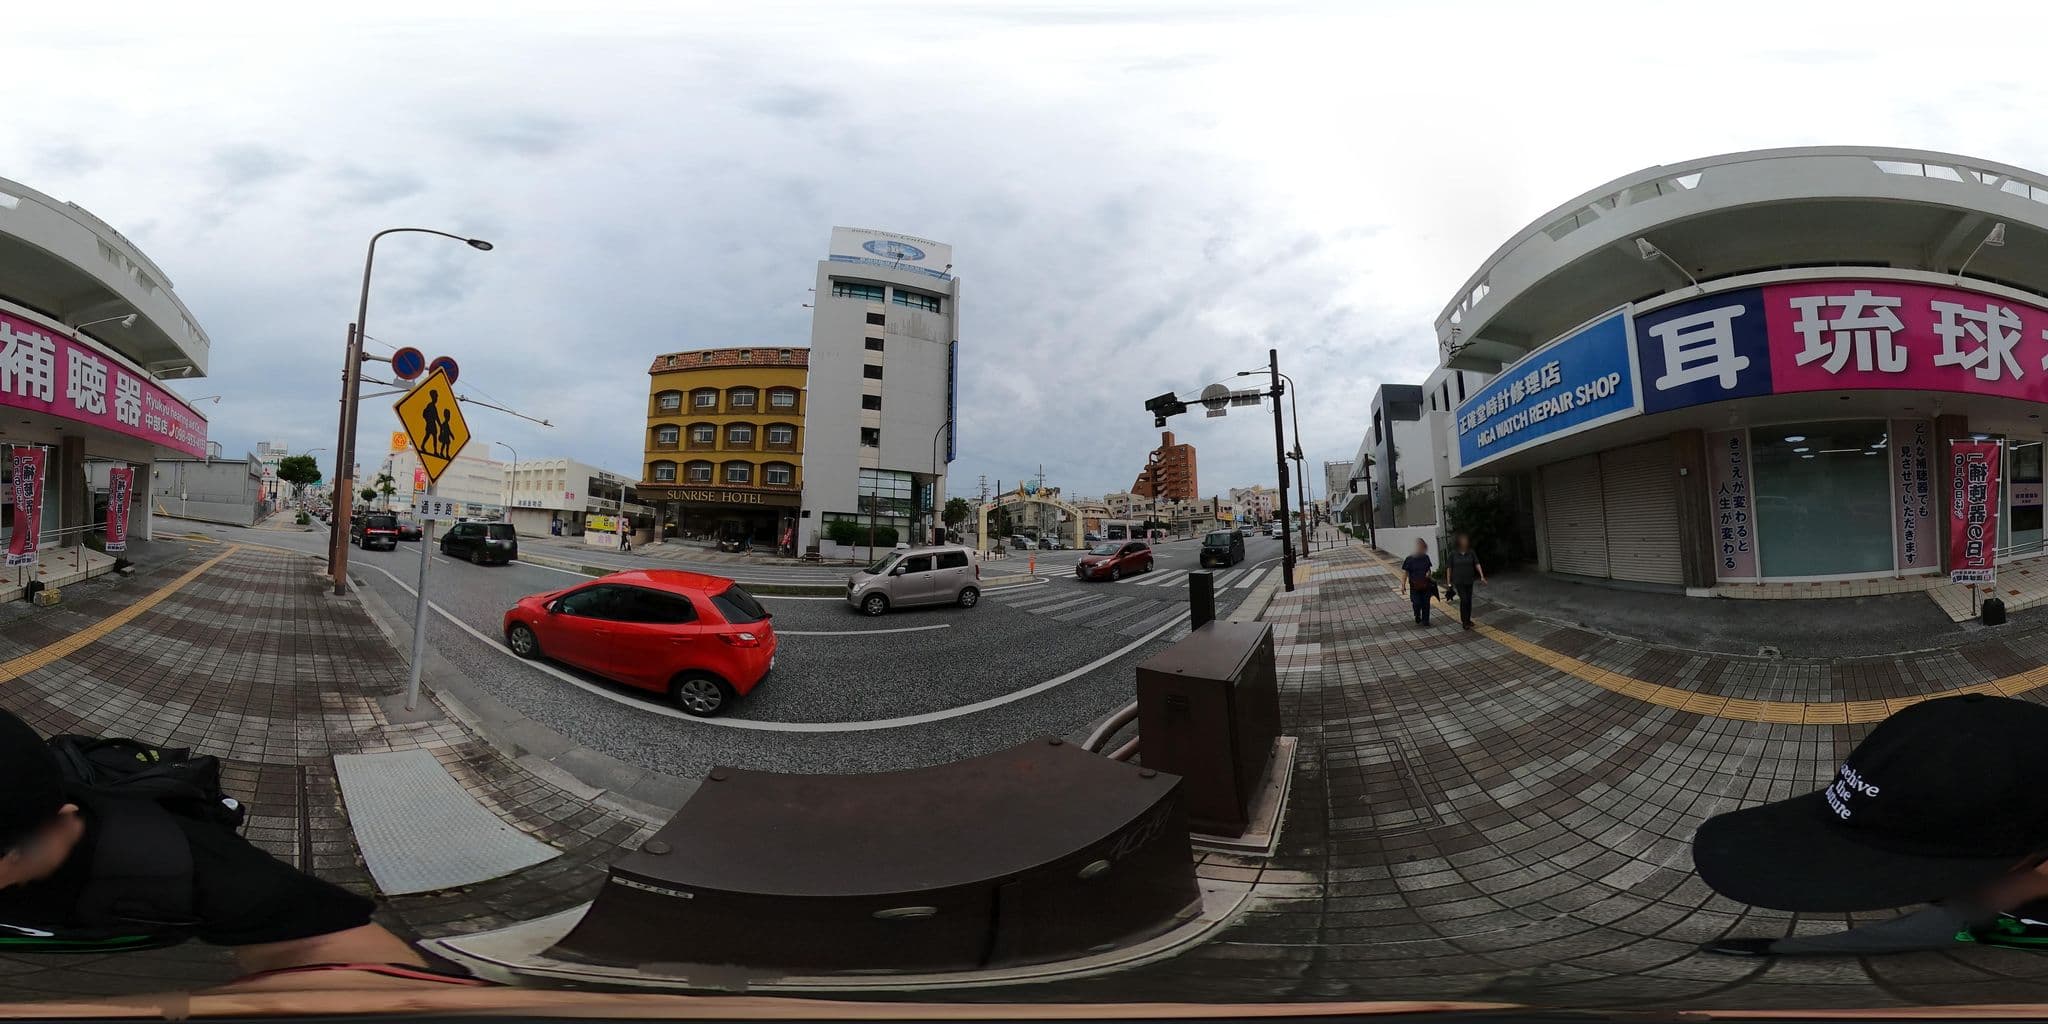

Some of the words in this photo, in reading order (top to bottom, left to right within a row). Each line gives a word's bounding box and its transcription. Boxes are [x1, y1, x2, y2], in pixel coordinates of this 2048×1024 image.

[0, 321, 141, 428] 補聴器
[1649, 304, 1750, 391] 耳
[1789, 289, 2048, 381] 琉球
[1477, 425, 1496, 448] HIGA
[1495, 409, 1529, 440] WATCH
[1529, 391, 1575, 424] REPAIR
[1576, 371, 1621, 406] SHOP
[421, 500, 452, 516] 通学路
[667, 489, 715, 502] SUNRISE
[722, 492, 765, 504] HOTEL
[1730, 437, 1749, 552] きこえが変わると
[1901, 446, 1916, 564] 見させていただきます
[1914, 422, 1929, 518] どんな補聴器でも
[1718, 482, 1736, 569] 人生が変わる
[1835, 779, 1851, 801] the
